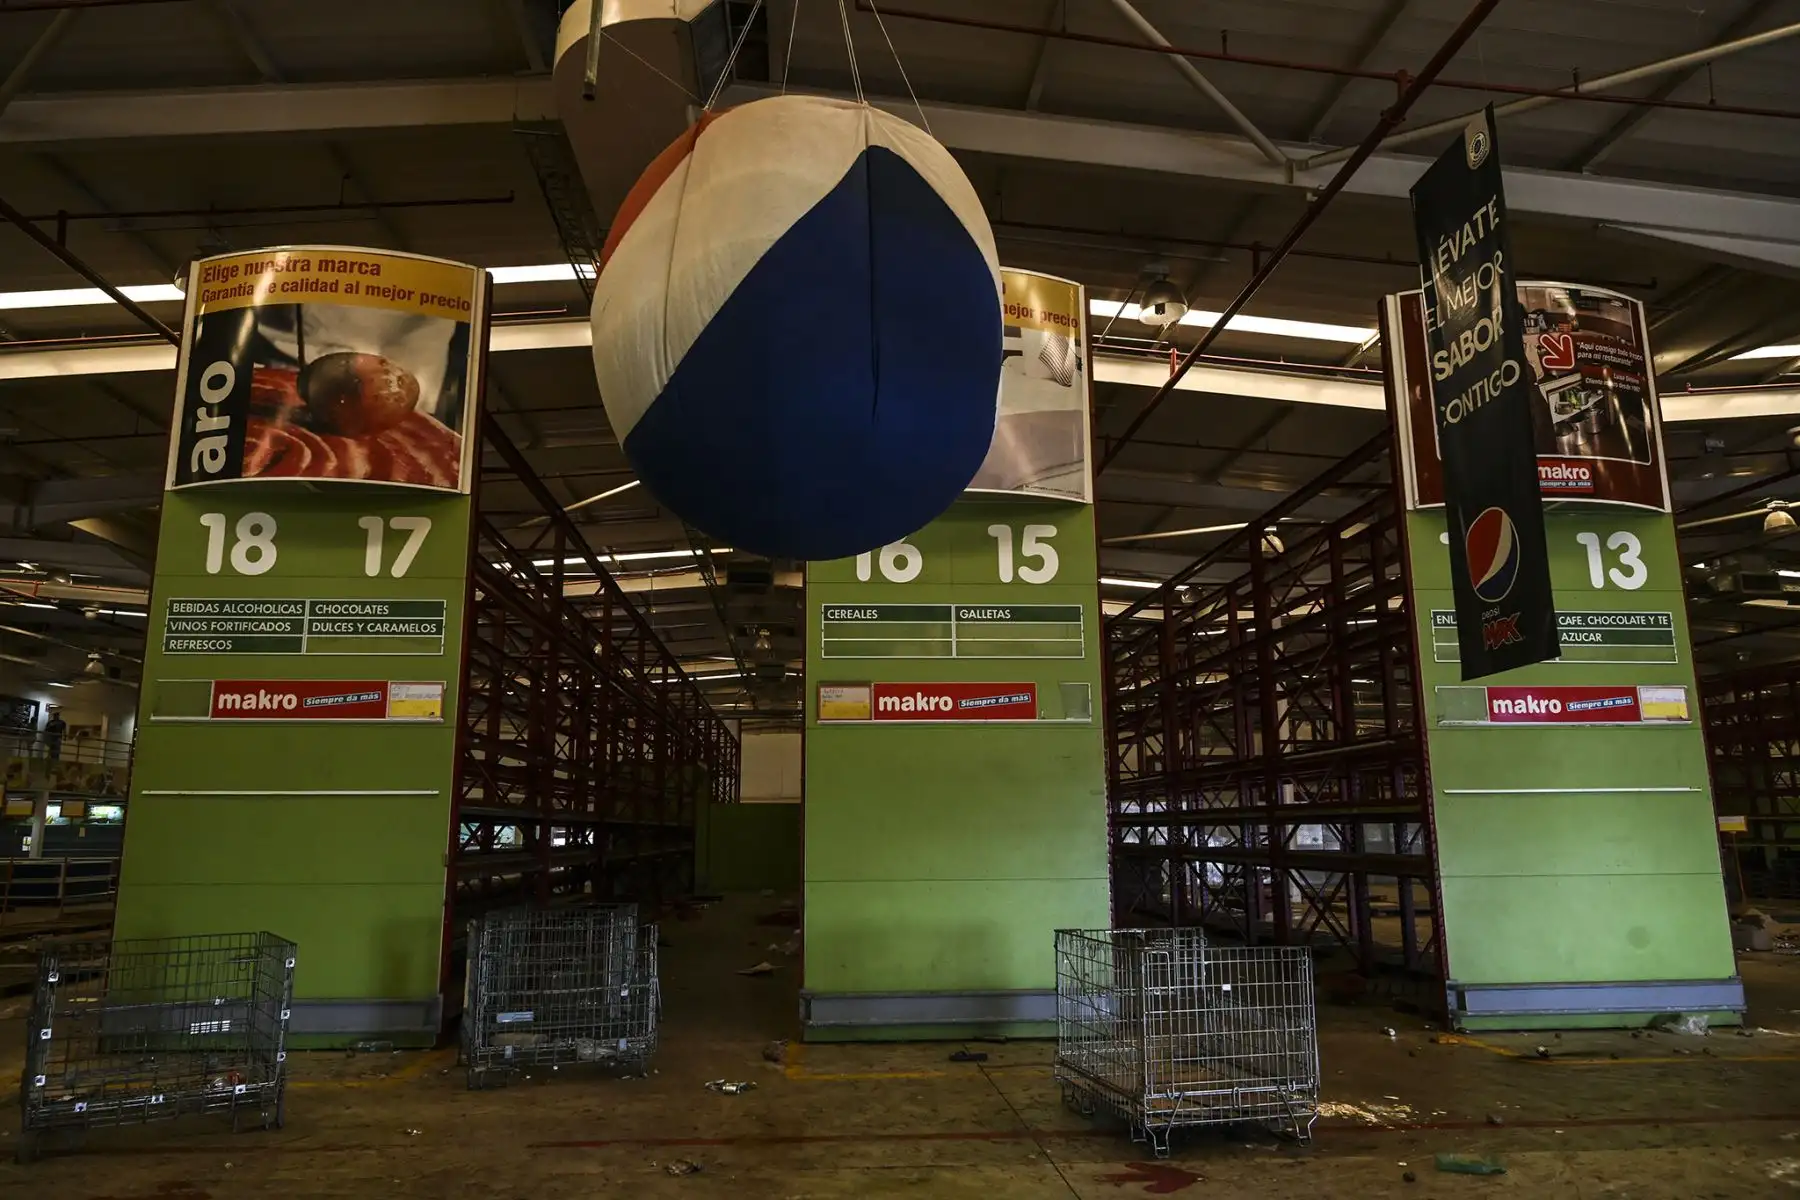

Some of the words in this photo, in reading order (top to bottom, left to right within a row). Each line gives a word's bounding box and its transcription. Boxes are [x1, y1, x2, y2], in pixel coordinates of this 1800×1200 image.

[203, 263, 240, 284] Elige
[244, 256, 311, 277] nuestra
[317, 258, 381, 276] marca
[1446, 249, 1505, 320] MEJOR
[201, 281, 254, 304] Garantía
[280, 276, 339, 294] calidad
[343, 281, 360, 294] al
[364, 284, 415, 302] mejor
[419, 293, 471, 313] precio
[1040, 309, 1078, 329] precio
[1433, 304, 1505, 384] SABOR
[191, 361, 235, 473] aro
[1538, 463, 1590, 480] makro
[200, 511, 278, 576] 18
[358, 515, 432, 578] 17
[987, 523, 1060, 584] 15
[1577, 531, 1647, 590] 13
[172, 602, 220, 614] BEBIDAS
[223, 603, 303, 615] ALCOHOLICAS
[315, 603, 390, 615] CHOCOLATES
[827, 608, 878, 620] CEREALES
[959, 608, 1012, 620] GALLETAS
[170, 620, 208, 632] VINOS
[210, 621, 291, 632] FORTIFICADOS
[312, 621, 355, 633] DULCES
[357, 622, 365, 633] Y
[366, 622, 437, 634] CARAMELOS
[1587, 616, 1646, 625] CHOCOLATE
[1647, 616, 1655, 625] Y
[1657, 616, 1669, 625] TE
[169, 639, 233, 650] REFRESCOS
[1561, 632, 1603, 642] AZUCAR
[217, 689, 298, 712] makro
[305, 695, 345, 707] Siempre
[346, 694, 359, 703] da
[878, 691, 953, 714] makro
[960, 696, 998, 708] Siempre
[999, 695, 1012, 704] da
[1493, 694, 1562, 715] makro
[1568, 700, 1601, 711] Siempre
[1601, 699, 1613, 707] da
